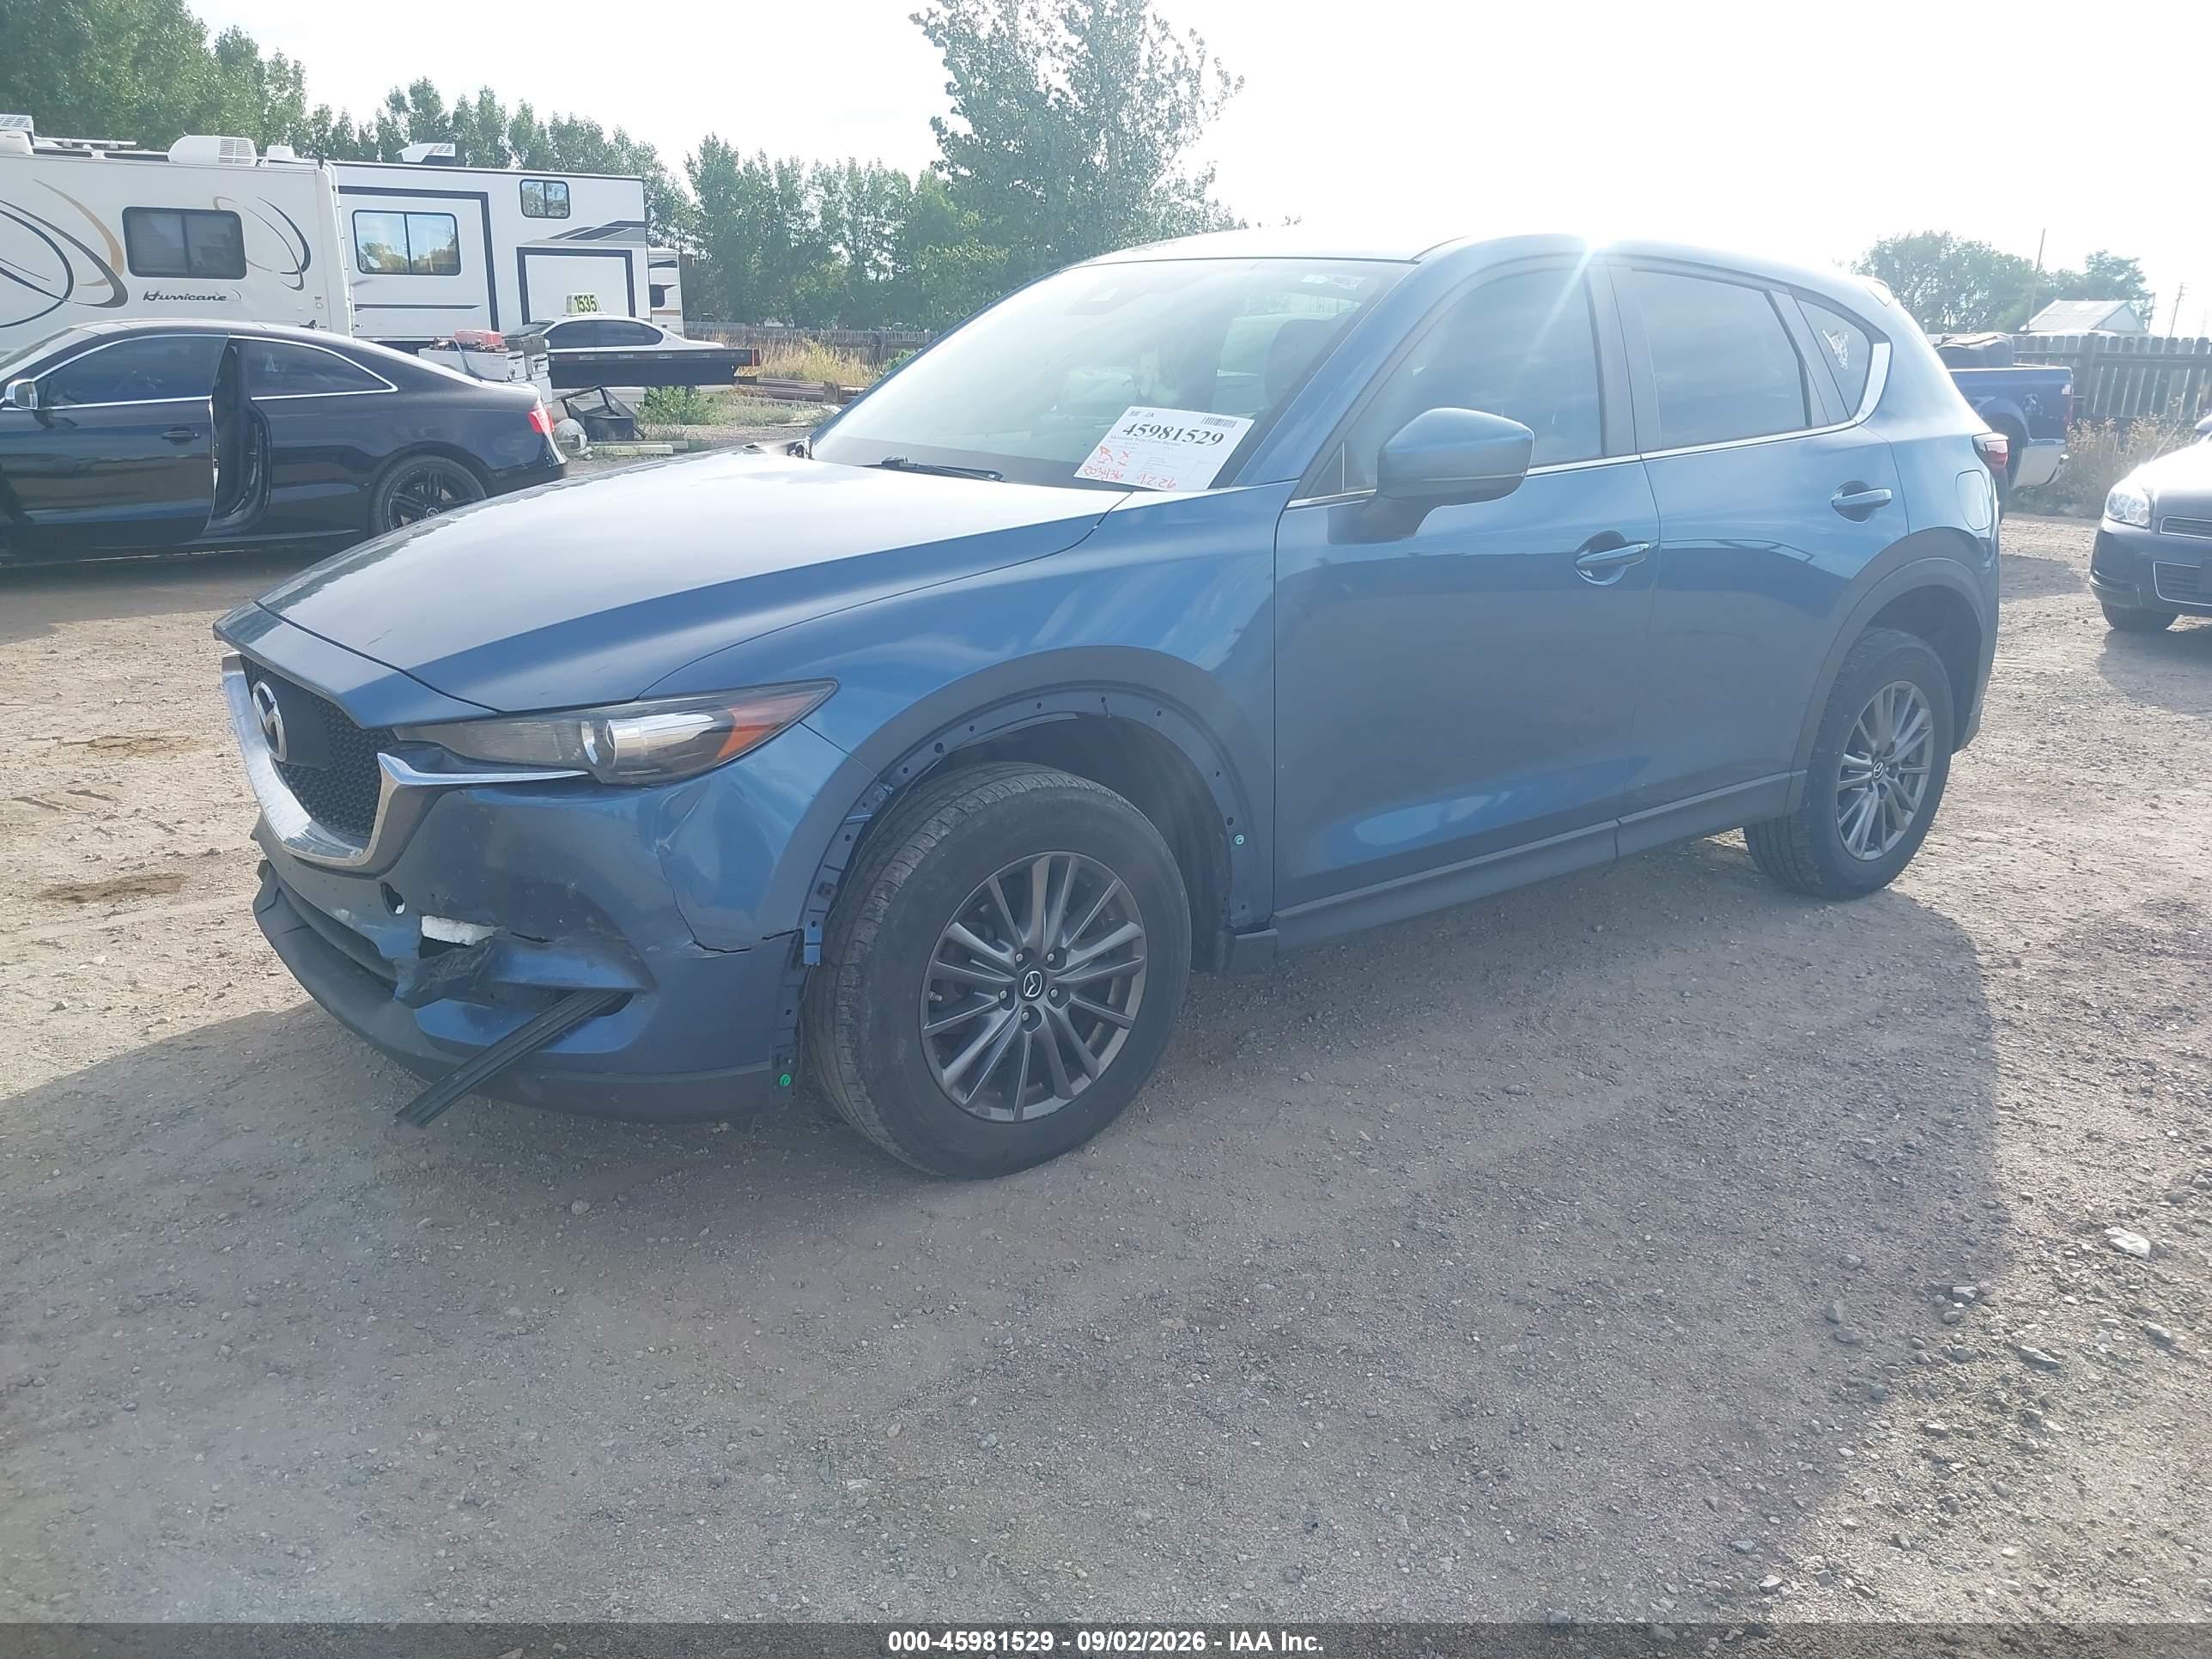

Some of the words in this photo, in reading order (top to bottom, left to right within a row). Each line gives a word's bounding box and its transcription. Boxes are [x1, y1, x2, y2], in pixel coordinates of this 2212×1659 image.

[143, 290, 228, 301] Hurricane
[574, 295, 598, 313] 1535
[1121, 422, 1224, 447] 45981529
